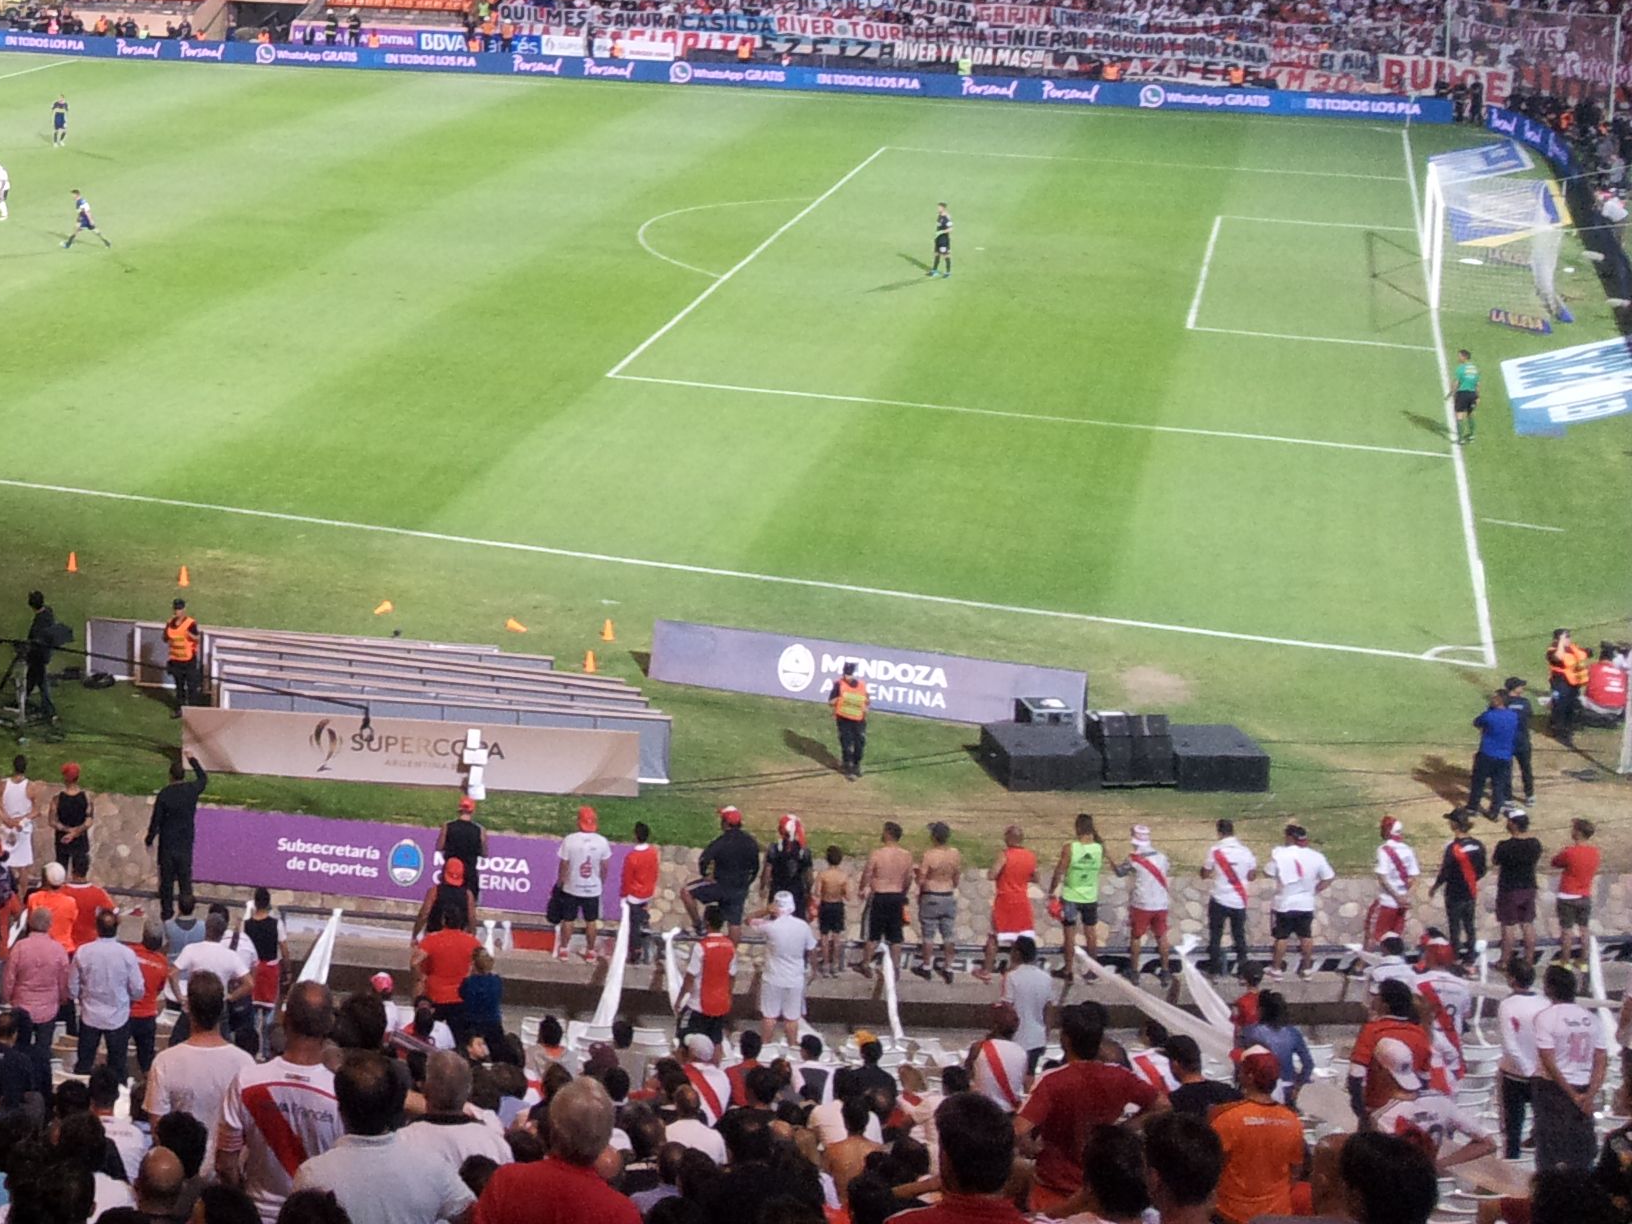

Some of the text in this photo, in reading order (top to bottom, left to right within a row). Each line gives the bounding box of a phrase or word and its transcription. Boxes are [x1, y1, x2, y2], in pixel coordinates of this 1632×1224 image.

[501, 6, 587, 26] QUILMES
[601, 11, 675, 29] SAKURA
[680, 15, 770, 34] CASILDA
[777, 16, 904, 41] RIVER TOUR
[421, 32, 467, 52] BBVA
[276, 49, 322, 63] WhatsApp
[322, 51, 358, 63] GRATIS
[894, 42, 936, 61] RIVER
[940, 45, 950, 61] Y
[951, 45, 993, 65] NADA
[693, 68, 744, 81] WhatsApp
[744, 69, 786, 83] GRATIS
[1166, 93, 1224, 106] WhatsApp
[1224, 93, 1271, 107] GRATIS
[1491, 309, 1508, 323] LA
[820, 678, 947, 709] AENTINA
[277, 837, 380, 861] Subsecretaría
[287, 858, 379, 879] de Deportes
